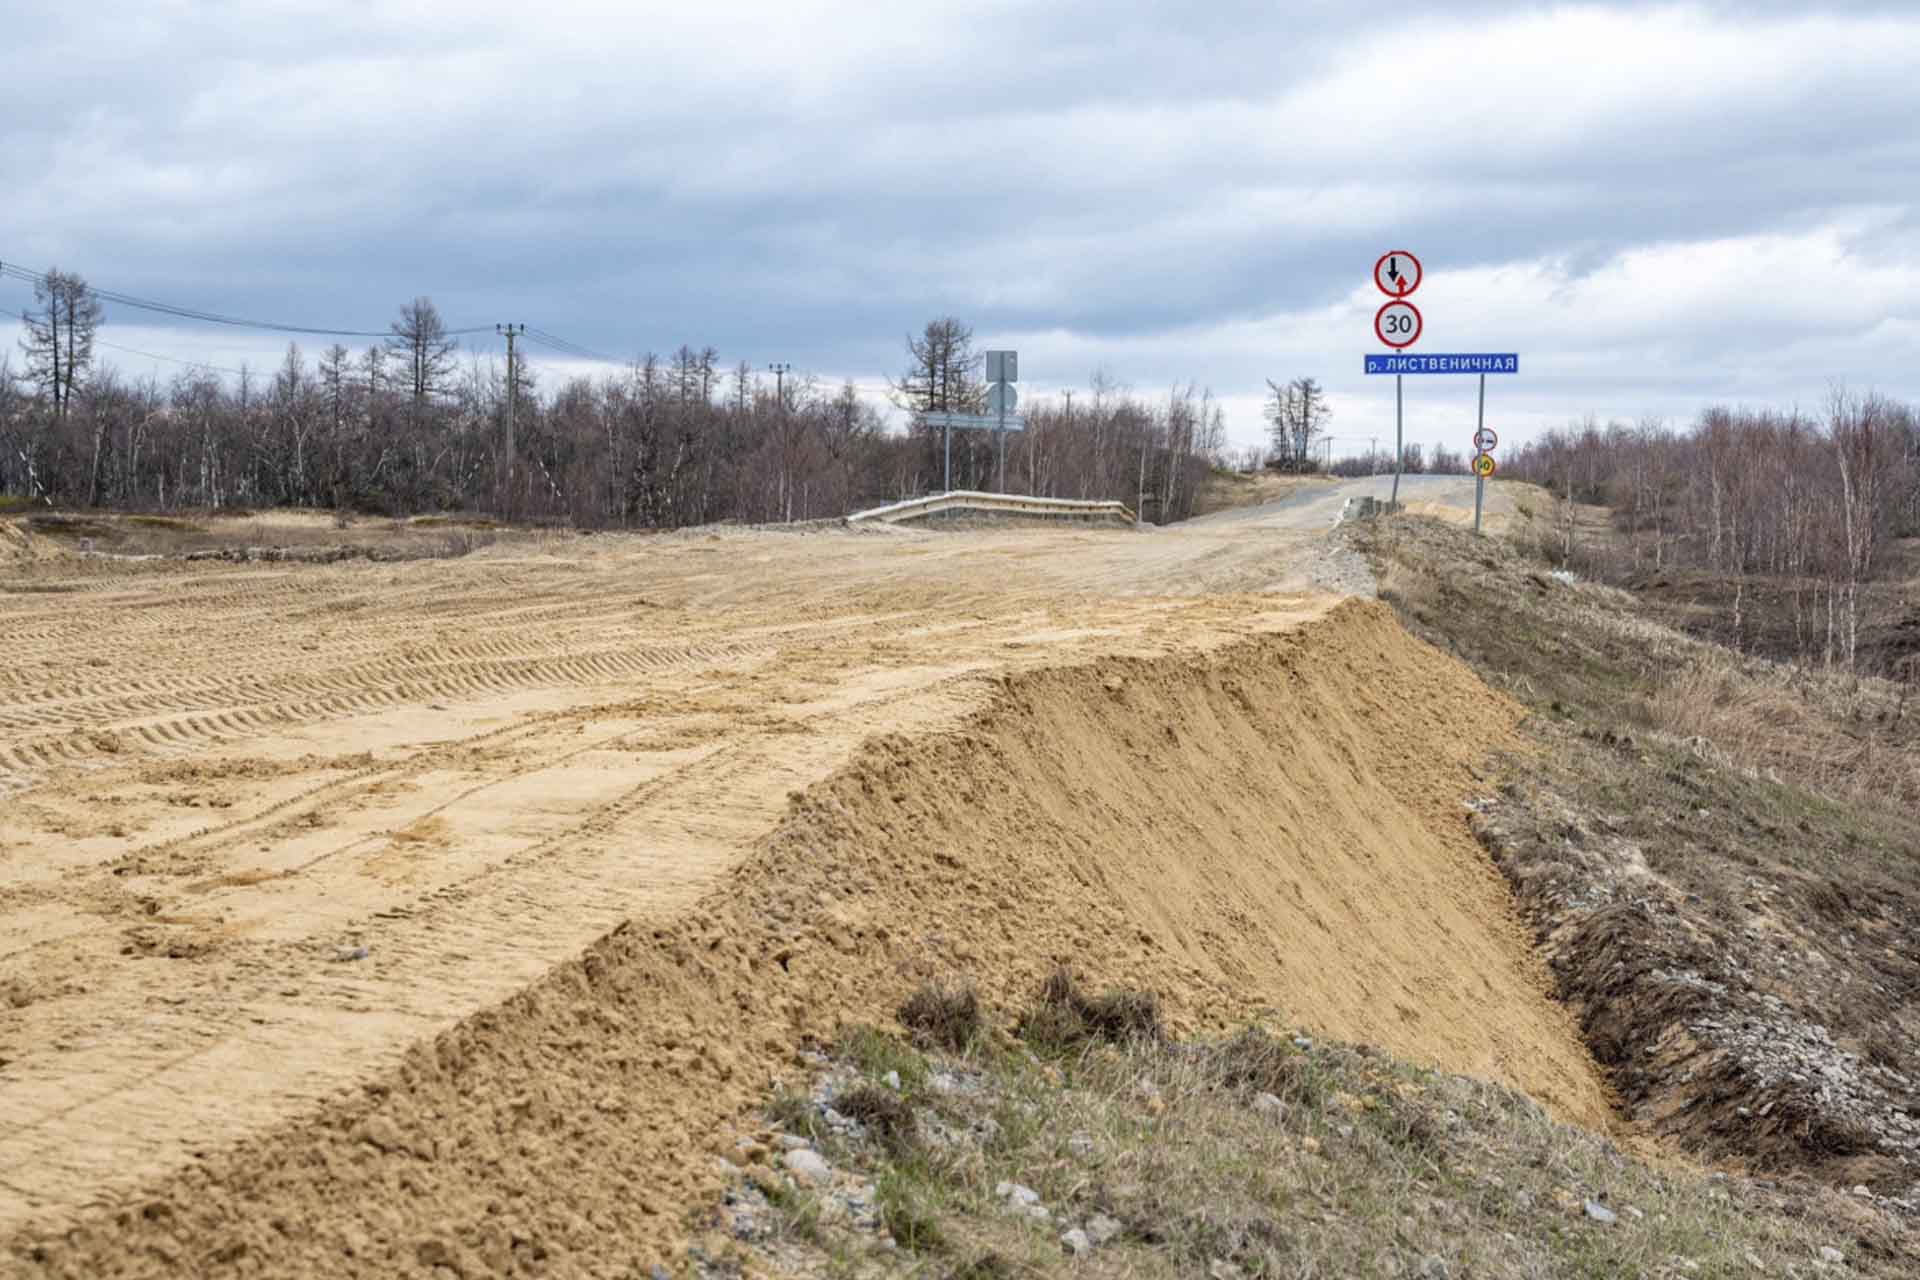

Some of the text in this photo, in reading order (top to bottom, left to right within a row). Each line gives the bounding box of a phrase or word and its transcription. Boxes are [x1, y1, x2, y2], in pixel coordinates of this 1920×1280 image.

[1386, 315, 1412, 334] 30
[1368, 358, 1514, 372] р. ЛИСТВЕНИЧНАЯ
